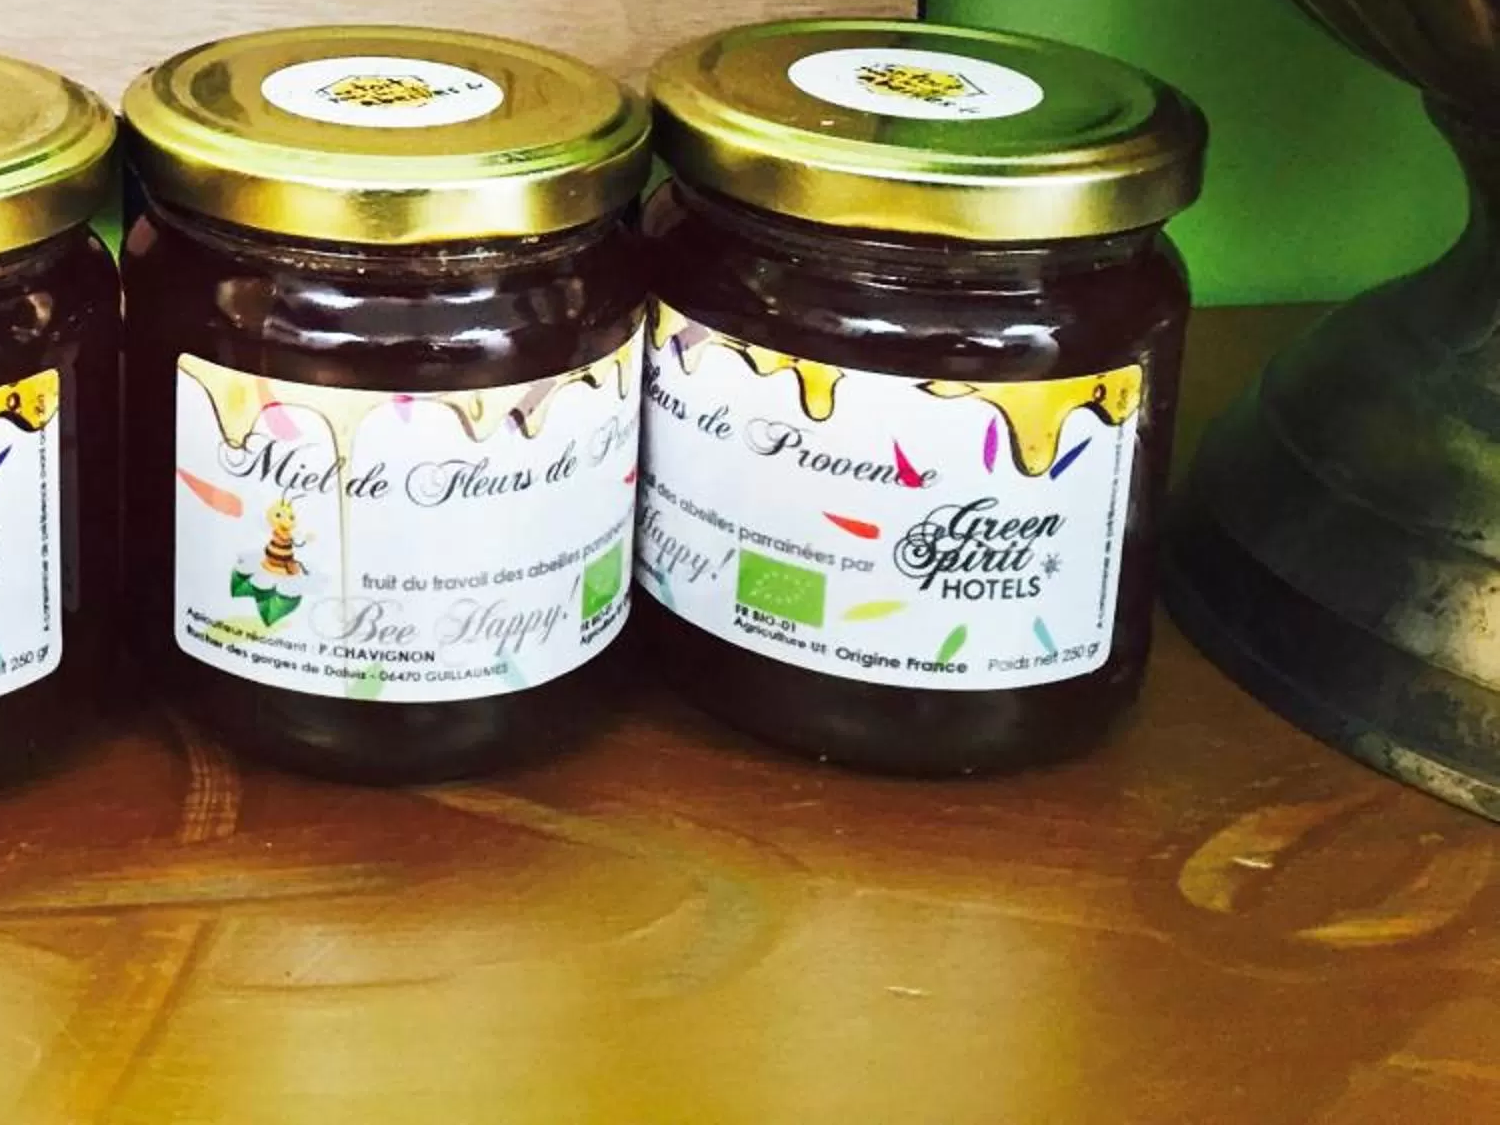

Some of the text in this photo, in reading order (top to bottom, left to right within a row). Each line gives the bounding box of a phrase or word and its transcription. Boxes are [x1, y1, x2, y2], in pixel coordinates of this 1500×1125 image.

[698, 405, 733, 440] de
[218, 433, 341, 495] Miel
[346, 461, 390, 499] de
[405, 457, 533, 507] Fleurs
[546, 439, 577, 484] de
[923, 497, 1066, 550] Green
[362, 550, 581, 591] fruit du travail des abeilles
[842, 554, 874, 572] par
[894, 522, 1034, 590] Spirit
[942, 576, 1040, 599] HOTELS
[308, 596, 416, 646] Bee
[436, 574, 581, 666] Happy!
[10, 651, 35, 670] 250
[301, 663, 319, 674] de
[835, 647, 967, 674] Origine France
[988, 654, 1028, 671] Poids
[1033, 648, 1058, 666] net
[1062, 644, 1084, 663] 250
